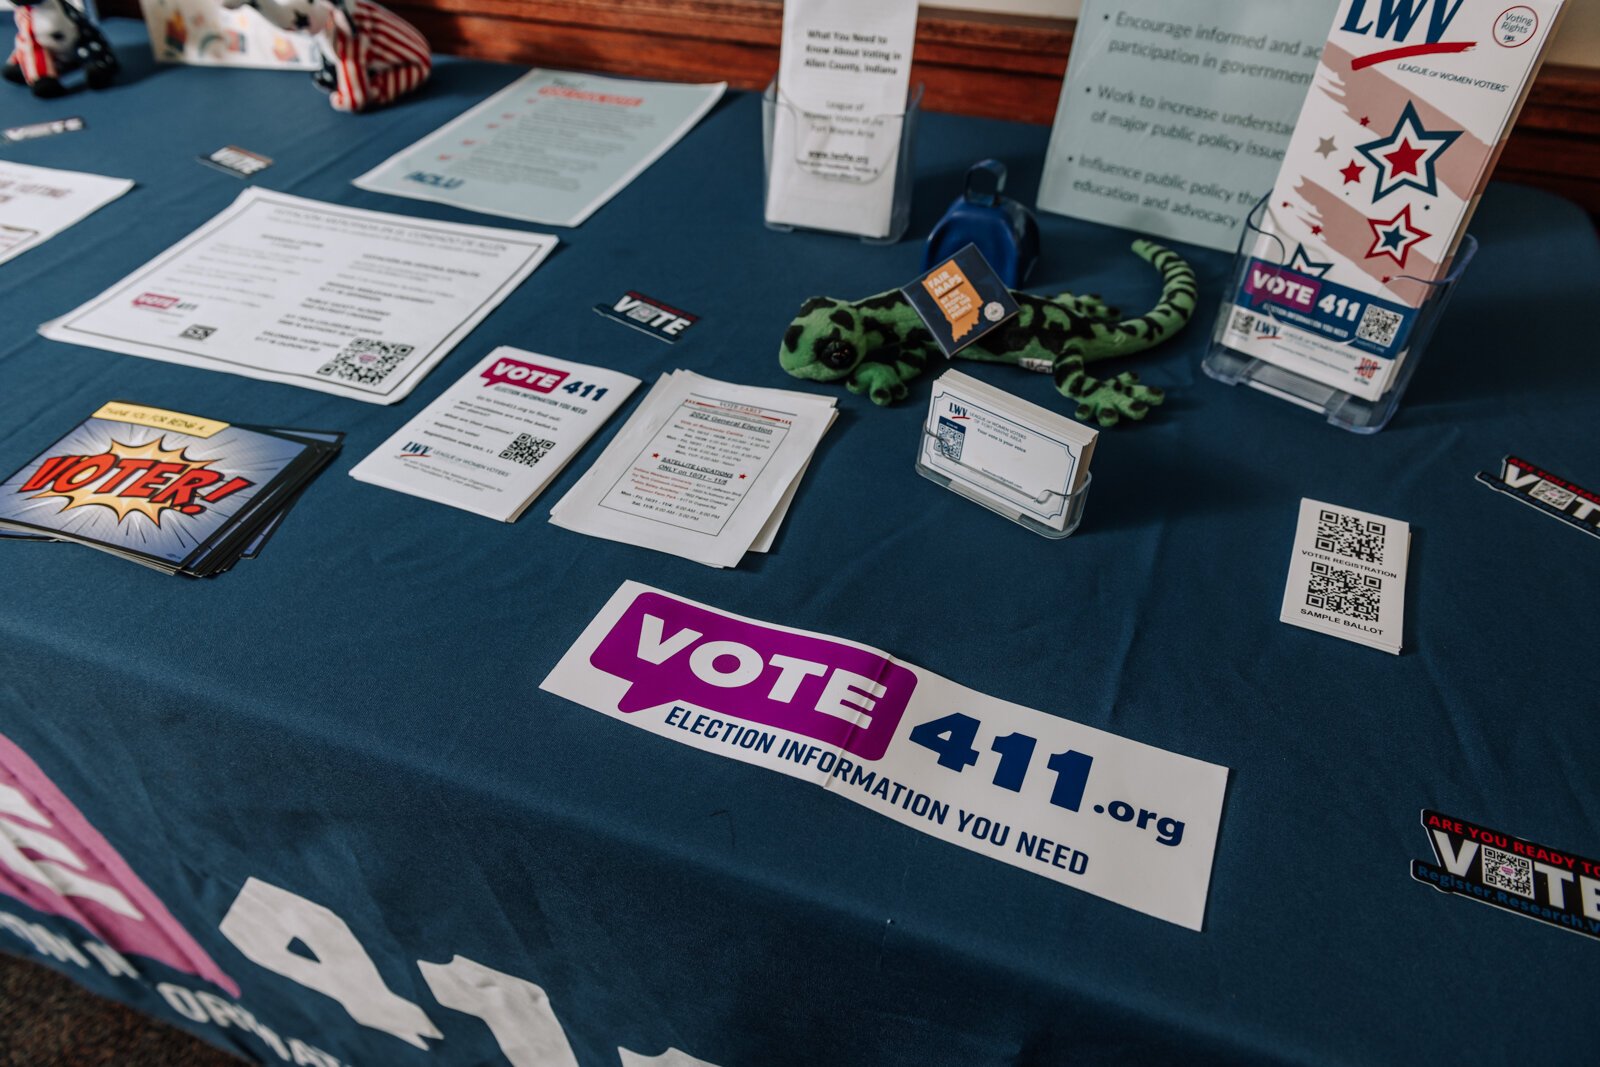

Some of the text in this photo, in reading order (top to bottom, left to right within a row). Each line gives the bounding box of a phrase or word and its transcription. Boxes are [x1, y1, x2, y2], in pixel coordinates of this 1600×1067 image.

[1501, 21, 1528, 33] Rights
[1505, 12, 1533, 26] Voting
[807, 29, 887, 44] What You Need to
[1115, 11, 1192, 39] Encourage
[1195, 23, 1266, 50] informed
[1269, 39, 1301, 57] and
[805, 44, 902, 61] Know About Voting in
[1108, 36, 1199, 67] participation
[1203, 53, 1217, 67] in
[804, 59, 826, 69] Allen
[864, 63, 897, 75] Indiana
[1397, 62, 1429, 76] LEAGUE
[1440, 71, 1472, 85] WOMEN
[1099, 84, 1136, 105] Work
[1140, 94, 1156, 108] to
[1158, 95, 1219, 121] increase
[1091, 110, 1107, 124] of
[1108, 115, 1149, 134] major
[1151, 120, 1196, 142] public
[1198, 131, 1243, 154] policy
[1079, 153, 1142, 180] Influence
[1144, 166, 1185, 191] public
[1189, 178, 1234, 202] policy
[1073, 179, 1240, 229] education and advocacy
[1253, 269, 1360, 321] VOTE 411
[492, 361, 609, 401] VOTE 411
[569, 406, 589, 414] NEED
[689, 411, 711, 419] 2022
[709, 416, 741, 427] General
[740, 423, 774, 434] Election
[949, 402, 967, 417] LWV
[991, 420, 1009, 432] WOMEN
[402, 441, 433, 455] LWV
[657, 463, 678, 472] ONLY
[660, 456, 697, 469] SATELLITE
[694, 465, 734, 479] LOCATIONS
[17, 453, 256, 515] VOTER!
[1302, 550, 1397, 579] VOTER REGISTRATION
[1300, 608, 1384, 636] SAMPLE BALLOT
[637, 613, 887, 730] VOTE
[664, 706, 1089, 876] ELECTION INFORMATION YOU NEED
[1429, 815, 1464, 835] ARE
[1468, 827, 1508, 848] YOU
[1513, 841, 1575, 869] READY
